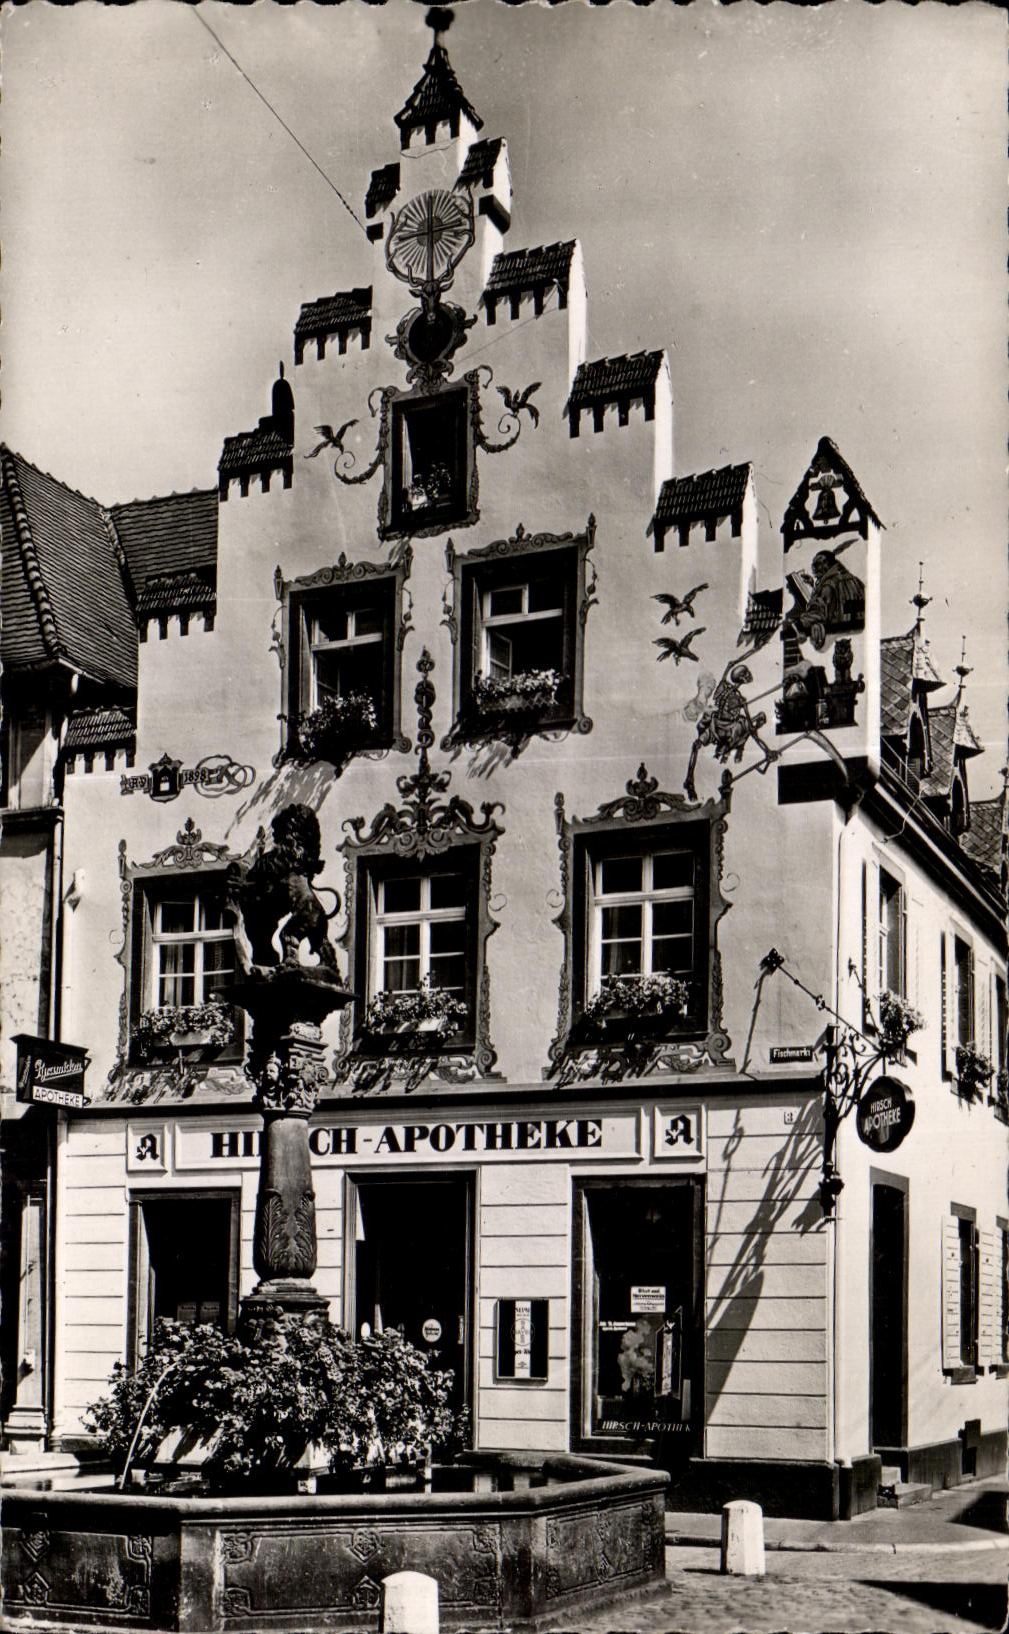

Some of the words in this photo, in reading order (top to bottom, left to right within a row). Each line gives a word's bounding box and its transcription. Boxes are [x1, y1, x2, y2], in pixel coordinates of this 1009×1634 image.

[184, 768, 207, 782] 1898
[773, 1047, 811, 1058] Fischmarkt
[34, 1088, 80, 1108] APOTHEKE
[870, 1096, 892, 1114] HIRSCH
[863, 1106, 901, 1135] APOTHEKE
[210, 1119, 602, 1158] HICH-APOTHEKE
[602, 1420, 692, 1433] HIRSCH-APOTHEK
